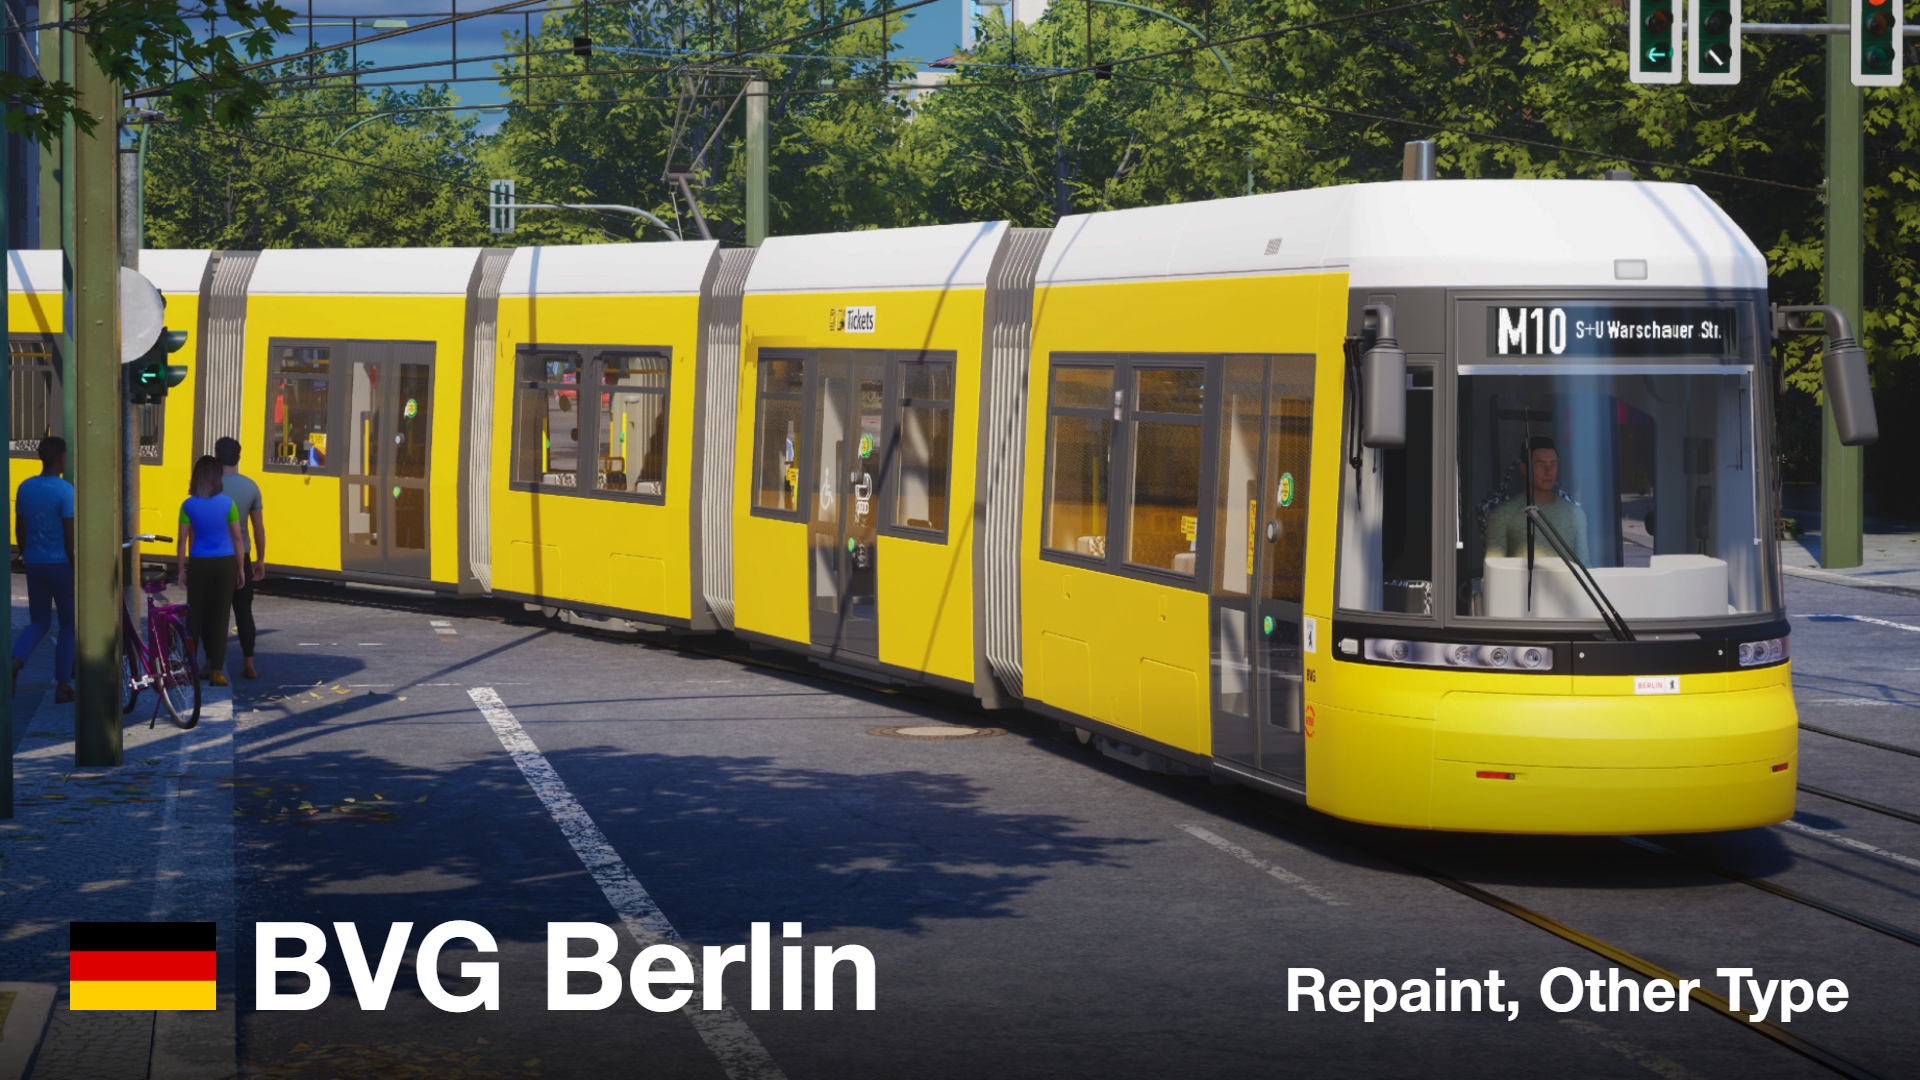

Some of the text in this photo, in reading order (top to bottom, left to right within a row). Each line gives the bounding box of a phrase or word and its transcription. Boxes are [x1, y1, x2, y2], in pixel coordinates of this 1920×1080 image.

[847, 309, 874, 330] Tickets
[1498, 308, 1722, 354] M10 S+U Warschauer Str.
